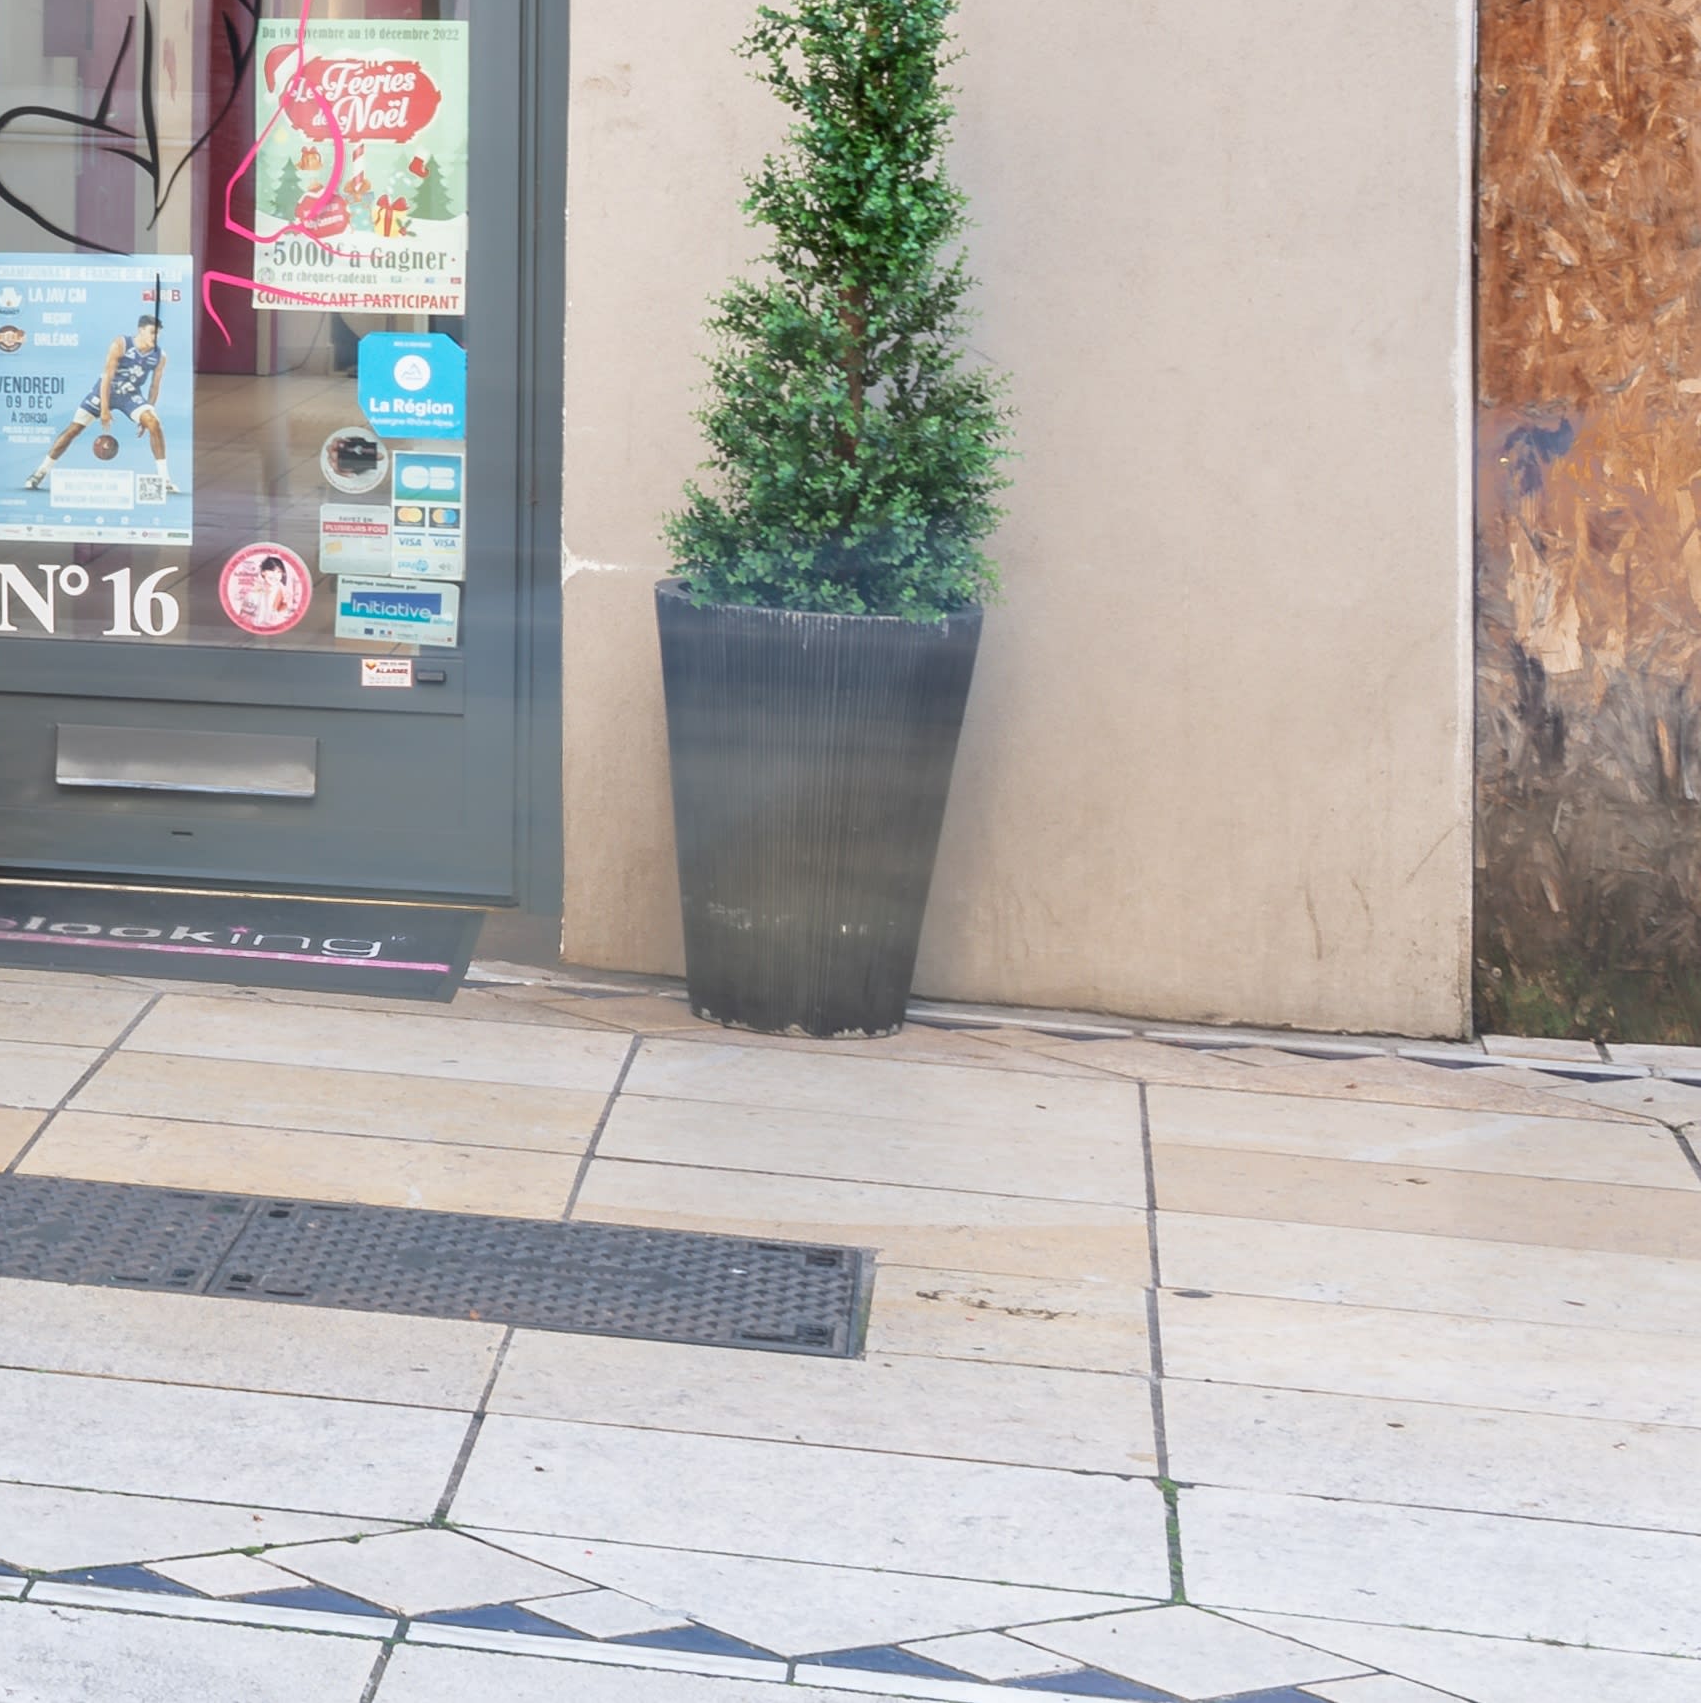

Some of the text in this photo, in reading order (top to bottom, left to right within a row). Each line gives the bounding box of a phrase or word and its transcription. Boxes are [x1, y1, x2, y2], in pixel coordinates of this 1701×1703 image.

[262, 28, 276, 39] Du
[295, 28, 345, 40] nvembre
[347, 29, 361, 40] au
[378, 27, 430, 41] décembre
[432, 29, 460, 41] 2022
[321, 62, 417, 102] Féeries
[333, 95, 409, 134] Noël
[370, 247, 448, 273] Gagner
[362, 293, 460, 310] PARTICIPANT
[34, 331, 79, 347] ORLÉANS
[5, 395, 22, 408] 09
[369, 397, 454, 418] La Région
[367, 526, 387, 534] FOIS
[398, 538, 422, 547] VISA
[433, 539, 456, 548] VISA
[101, 566, 180, 637] 16
[352, 598, 432, 619] Initiative
